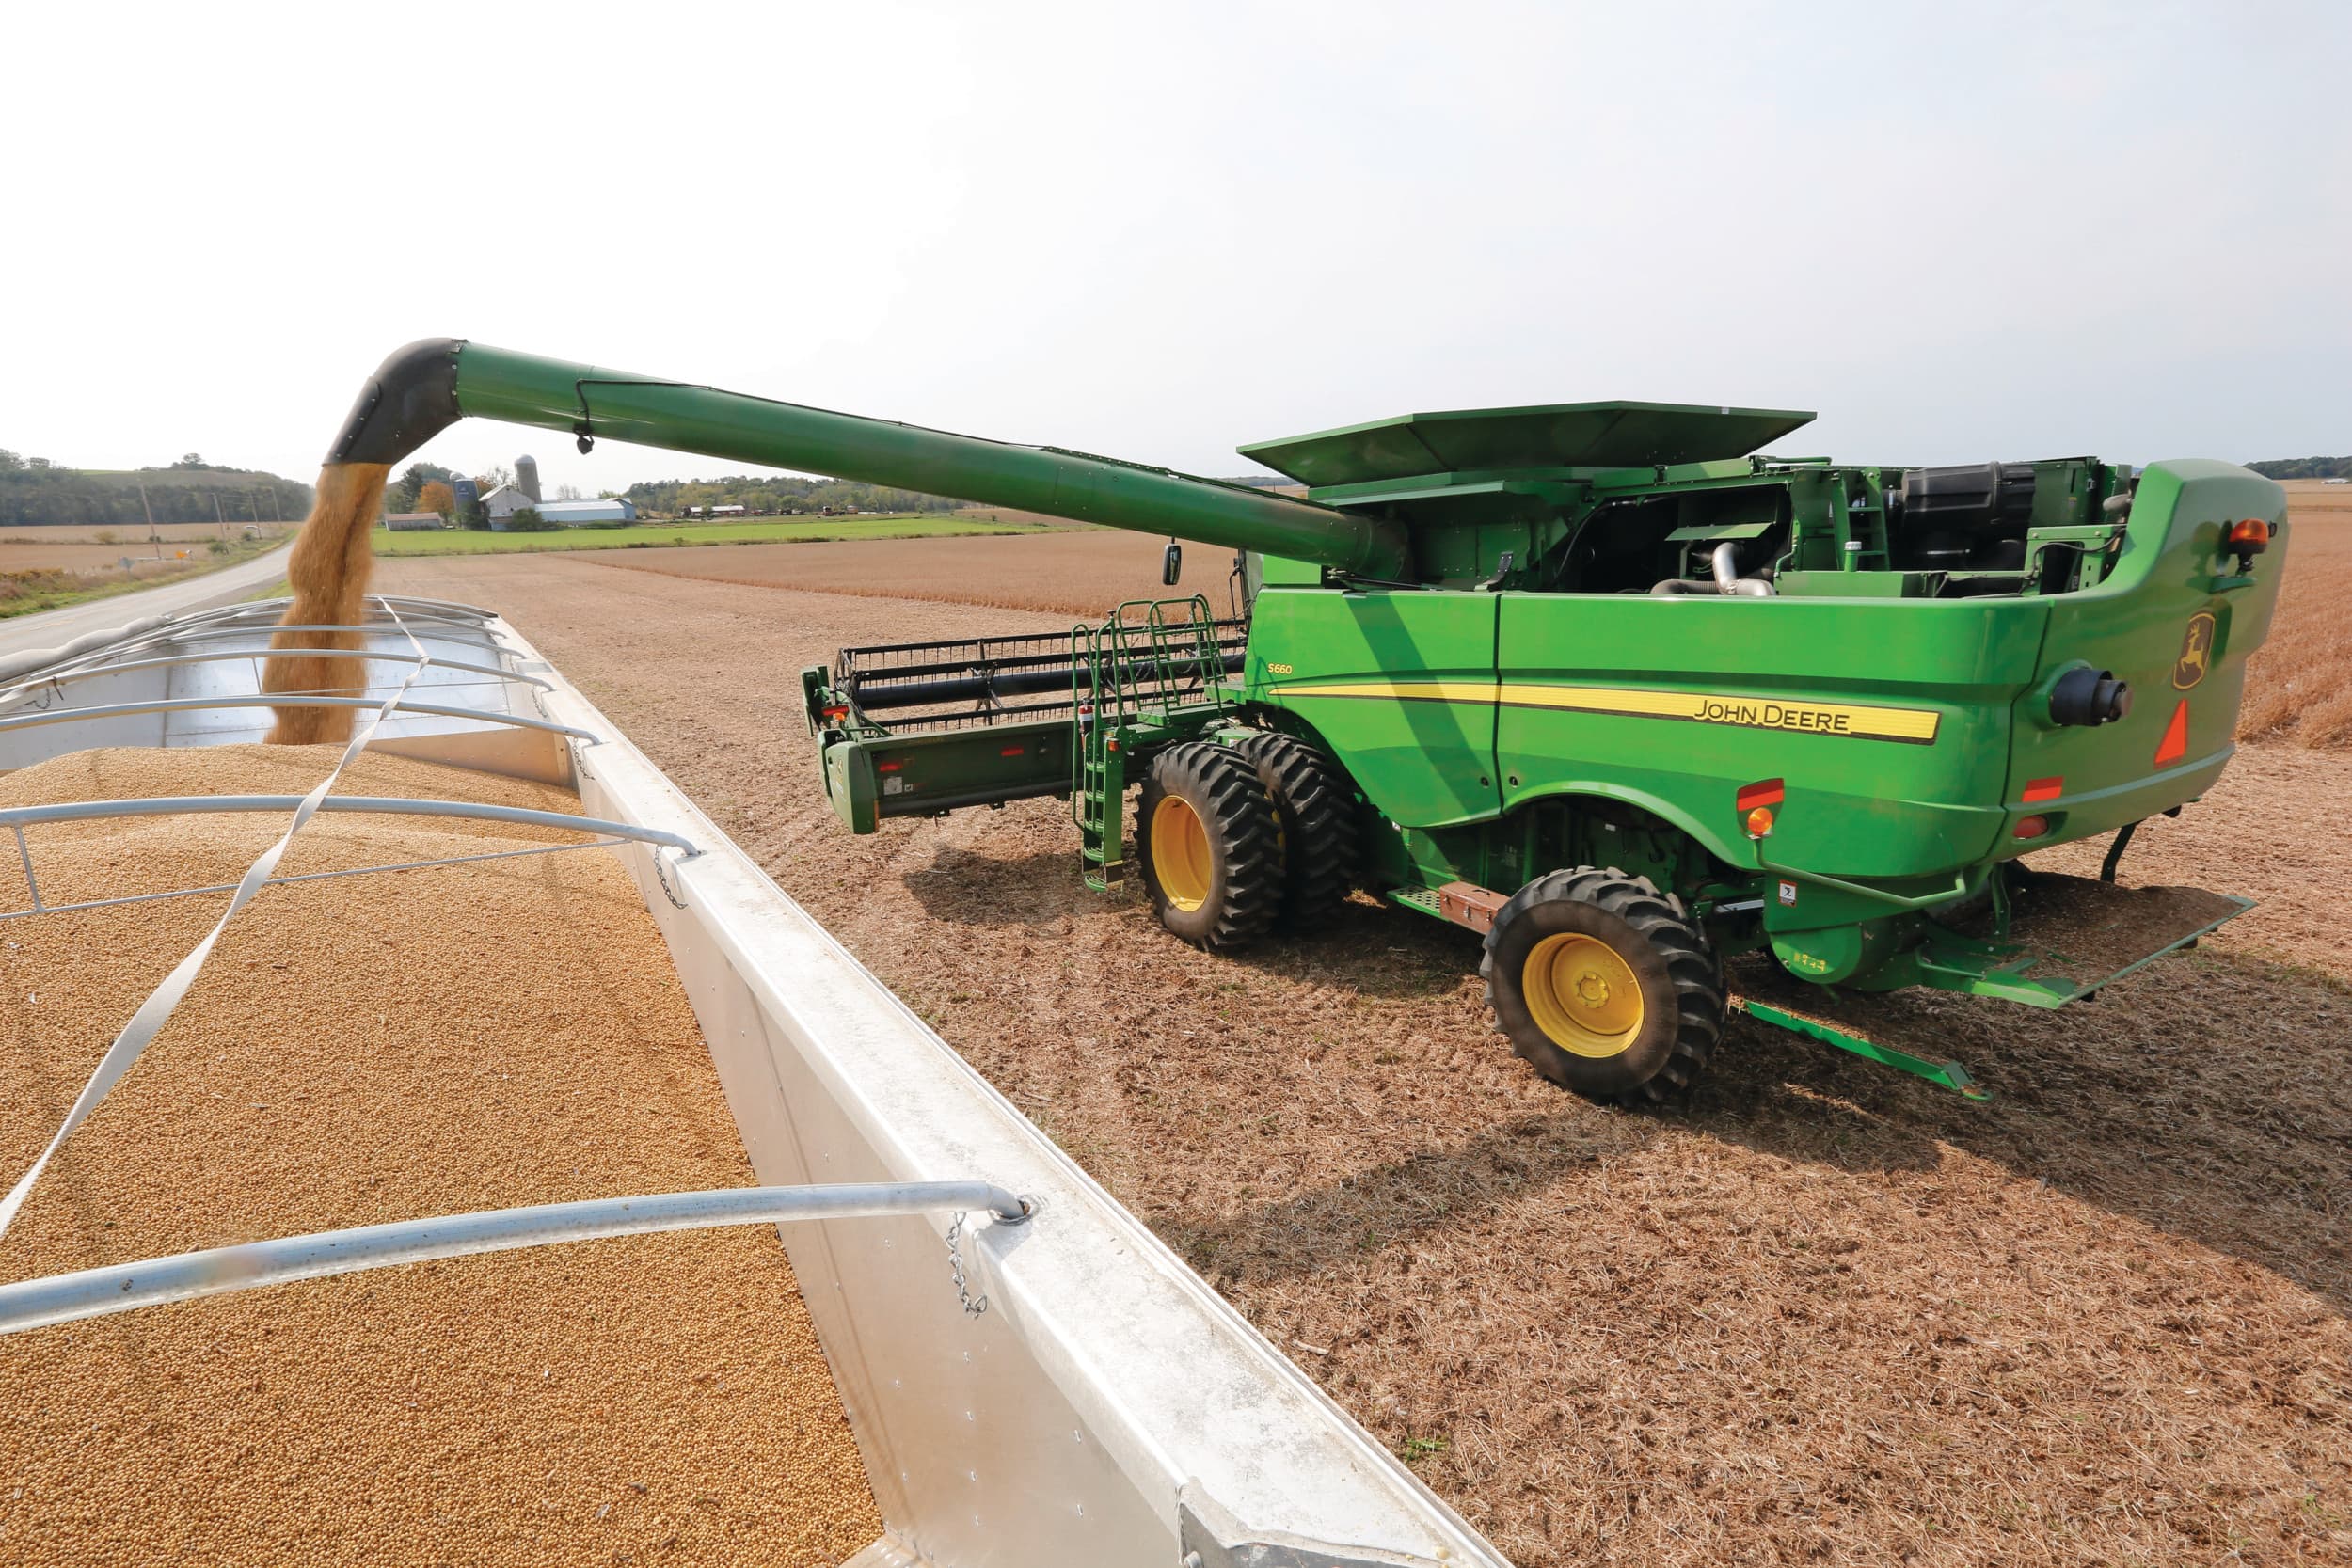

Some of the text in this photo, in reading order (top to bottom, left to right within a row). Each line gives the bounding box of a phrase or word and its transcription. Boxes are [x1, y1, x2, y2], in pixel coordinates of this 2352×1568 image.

[1267, 662, 1293, 675] S660
[1694, 699, 1851, 731] JOHN DEERE
